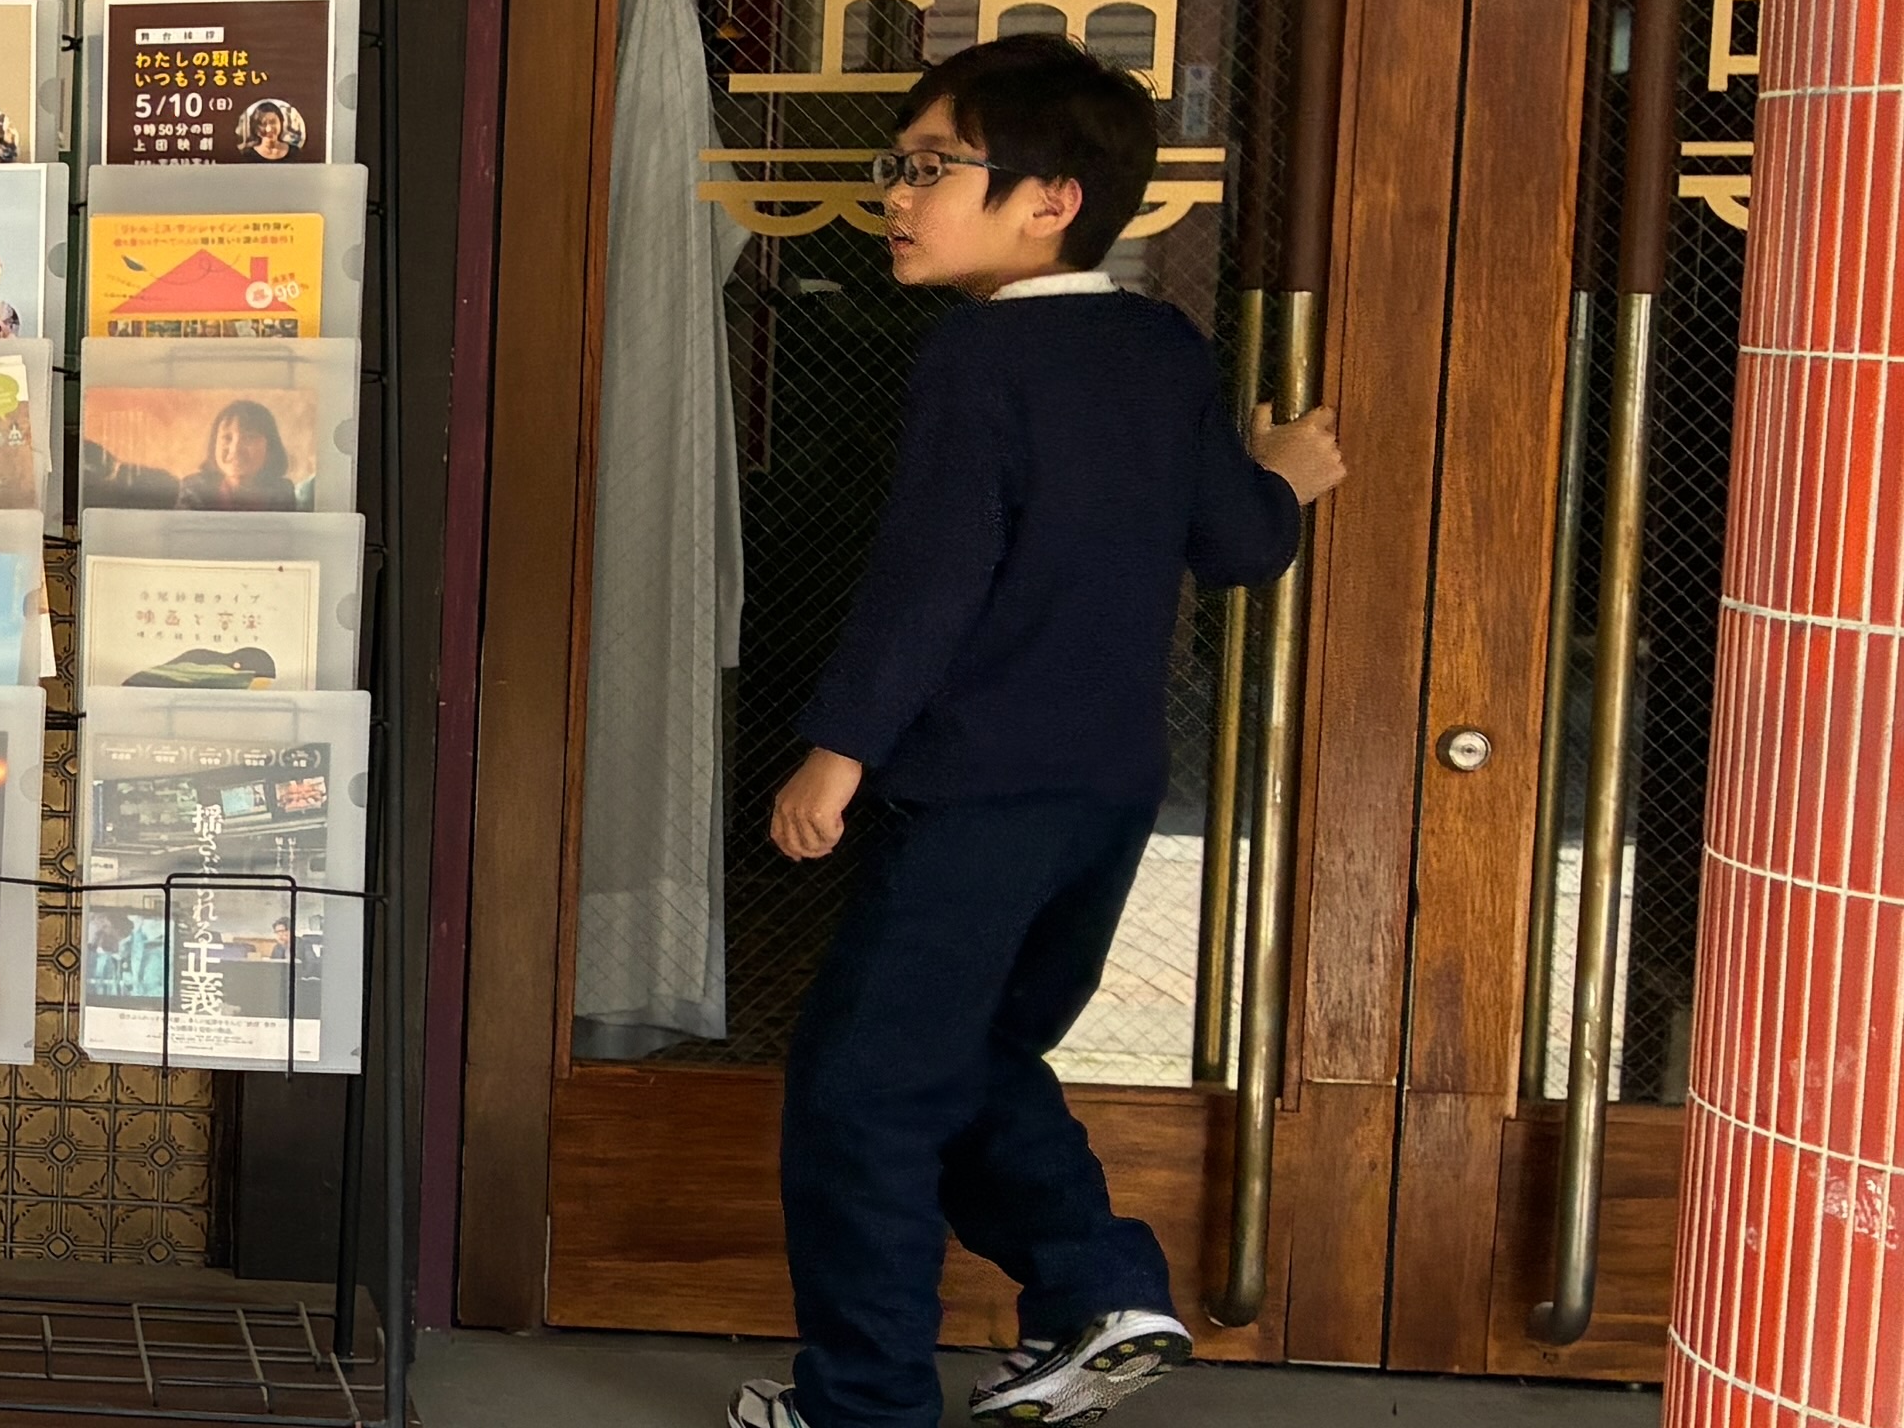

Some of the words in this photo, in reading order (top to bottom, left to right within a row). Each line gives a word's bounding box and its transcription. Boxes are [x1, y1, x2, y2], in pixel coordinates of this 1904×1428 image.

[135, 49, 249, 69] わたしの頭は
[135, 69, 269, 88] いつもうるさい
[134, 92, 204, 119] 5/10
